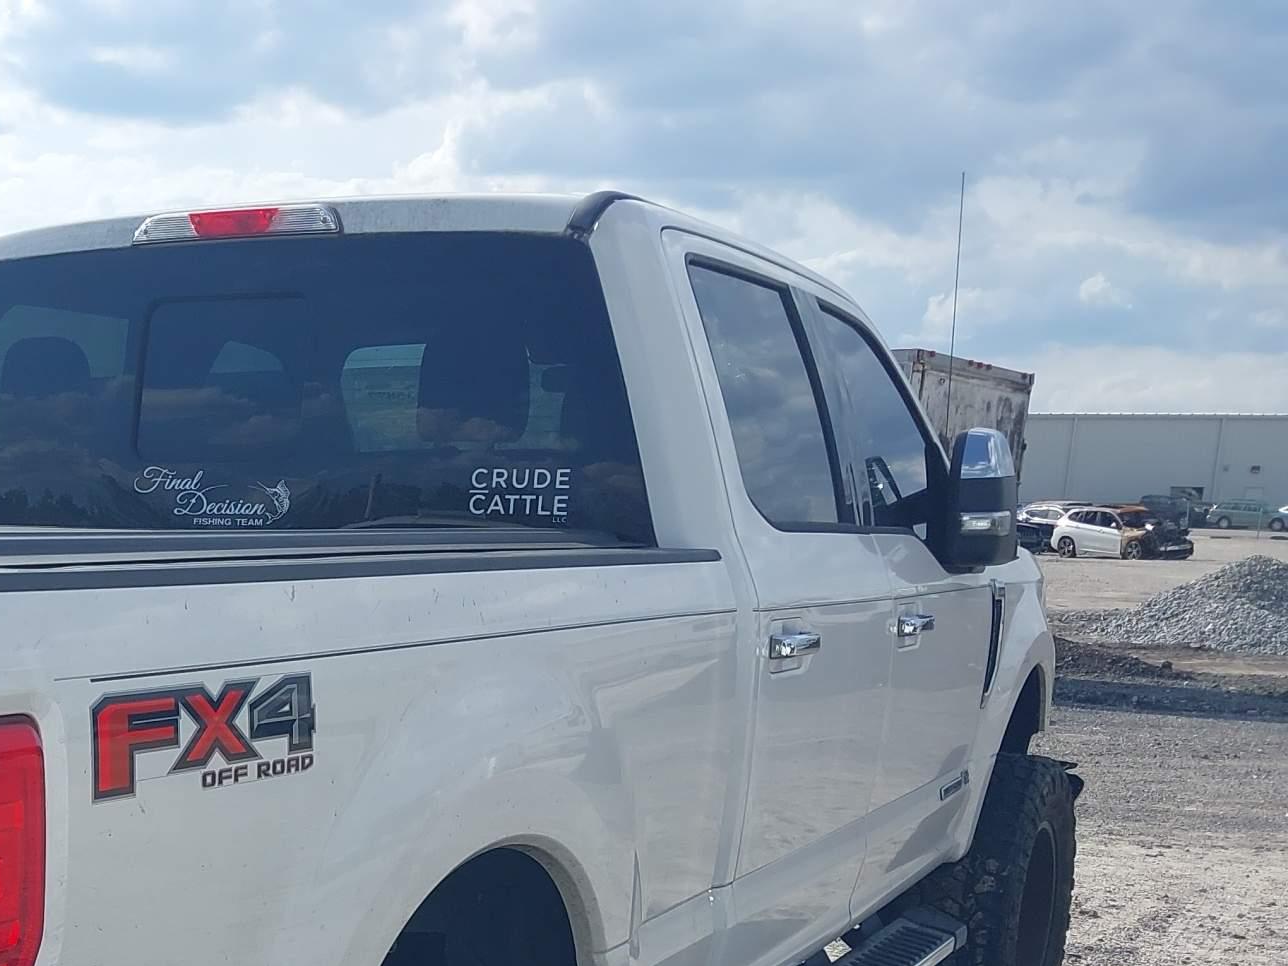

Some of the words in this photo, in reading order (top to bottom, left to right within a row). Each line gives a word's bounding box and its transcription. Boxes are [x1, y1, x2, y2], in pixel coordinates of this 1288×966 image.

[133, 466, 203, 494] Final
[471, 468, 571, 489] CRUDE
[173, 490, 266, 516] Decision
[469, 494, 569, 516] CATTLE
[193, 518, 232, 526] FISHING
[236, 518, 263, 526] TEAM
[89, 672, 316, 806] FX4
[201, 765, 248, 789] OFF
[256, 753, 314, 780] ROAD
